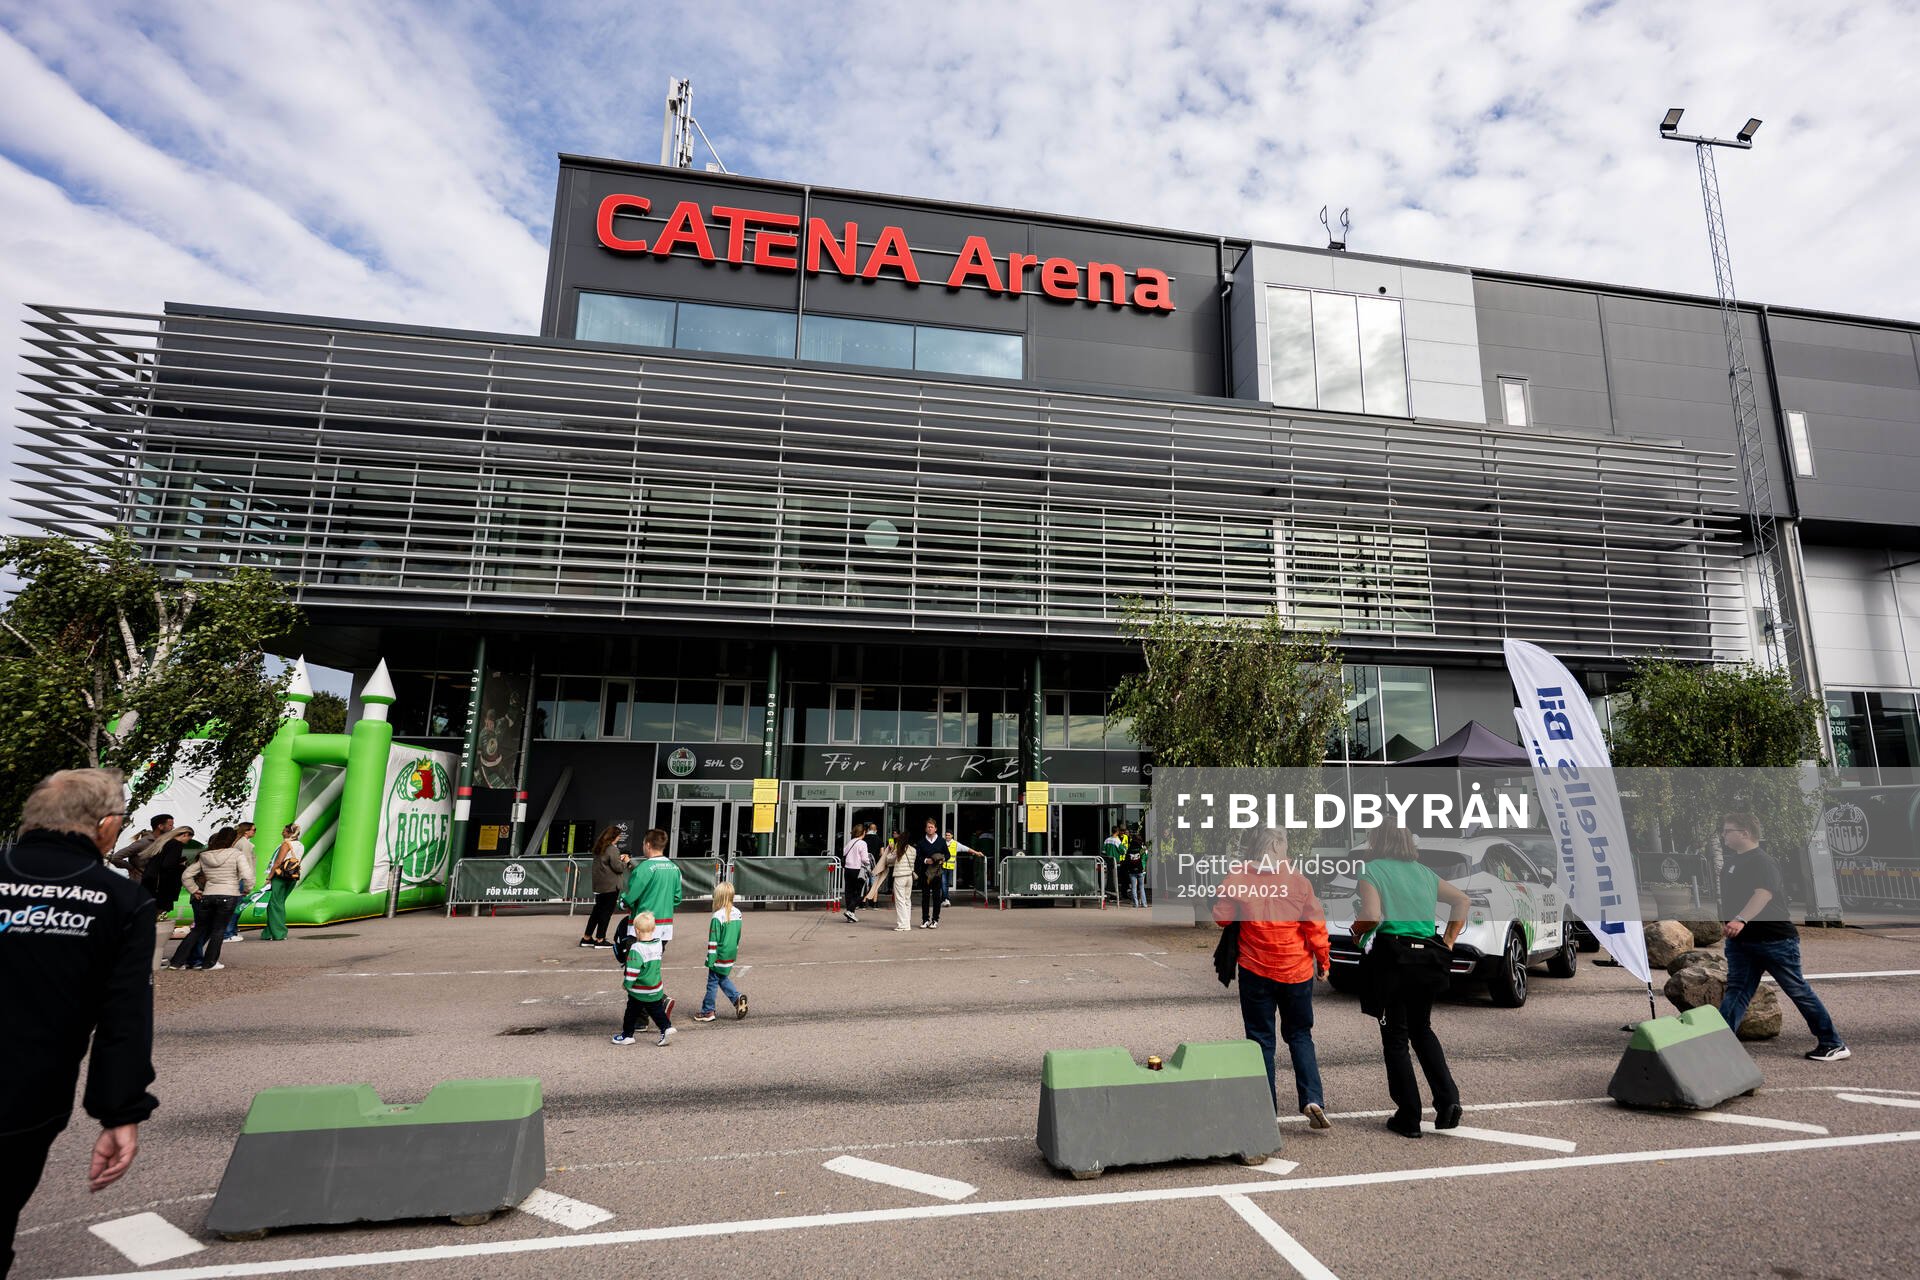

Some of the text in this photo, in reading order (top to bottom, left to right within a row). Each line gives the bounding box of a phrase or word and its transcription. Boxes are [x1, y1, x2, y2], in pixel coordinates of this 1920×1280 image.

[597, 193, 1175, 312] CATENA Arena
[764, 693, 776, 756] RÖGLE BK
[1830, 726, 1848, 736] RBK
[704, 759, 726, 768] SHL
[821, 752, 867, 776] För
[881, 754, 941, 772] vårt
[1121, 765, 1140, 773] SHL
[396, 807, 449, 843] RÖGLE
[1827, 823, 1864, 843] RÖGLE
[486, 886, 540, 896] FÖR VÅRT RBK
[1030, 882, 1074, 891] FÖR VÅRT RBK
